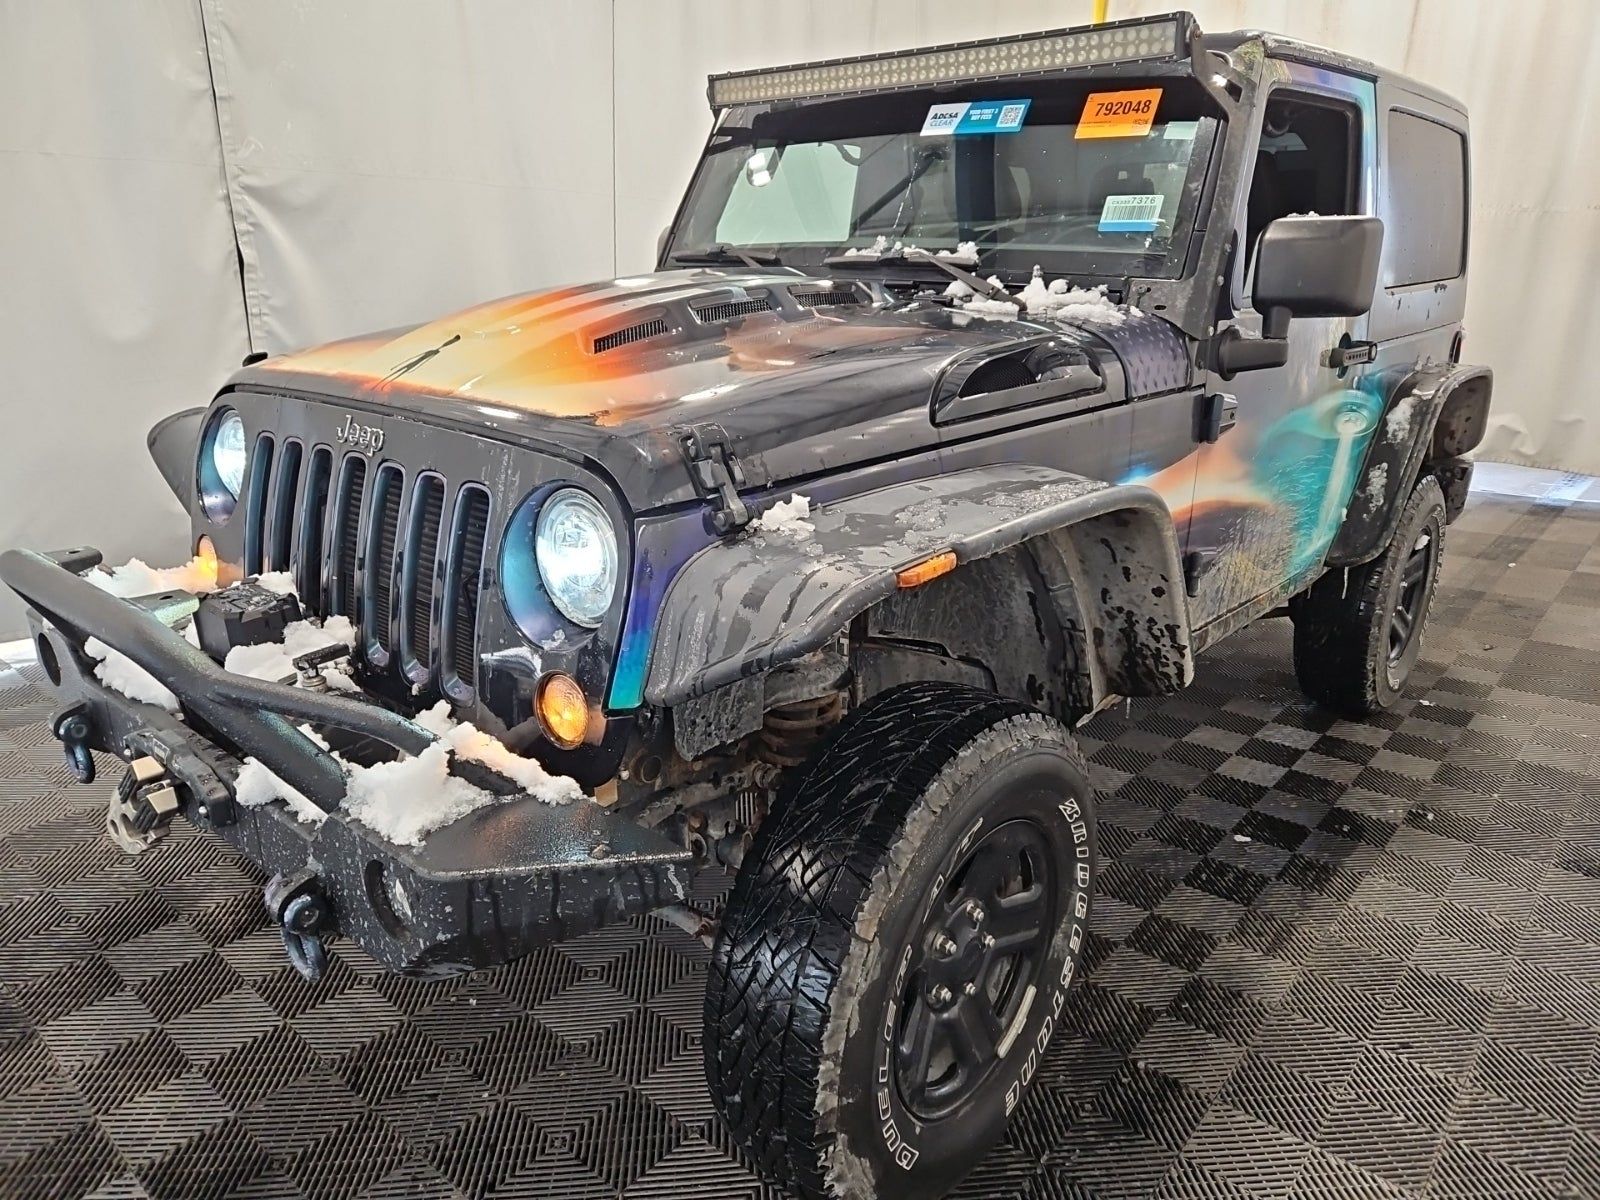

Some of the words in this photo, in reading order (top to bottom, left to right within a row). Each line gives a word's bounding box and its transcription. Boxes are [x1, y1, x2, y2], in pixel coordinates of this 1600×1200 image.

[930, 112, 959, 120] ADESA
[1095, 99, 1152, 117] 792048
[930, 119, 954, 127] CLEAR
[336, 414, 384, 457] Jeep
[1004, 798, 1090, 1117] BRIDGESTONE
